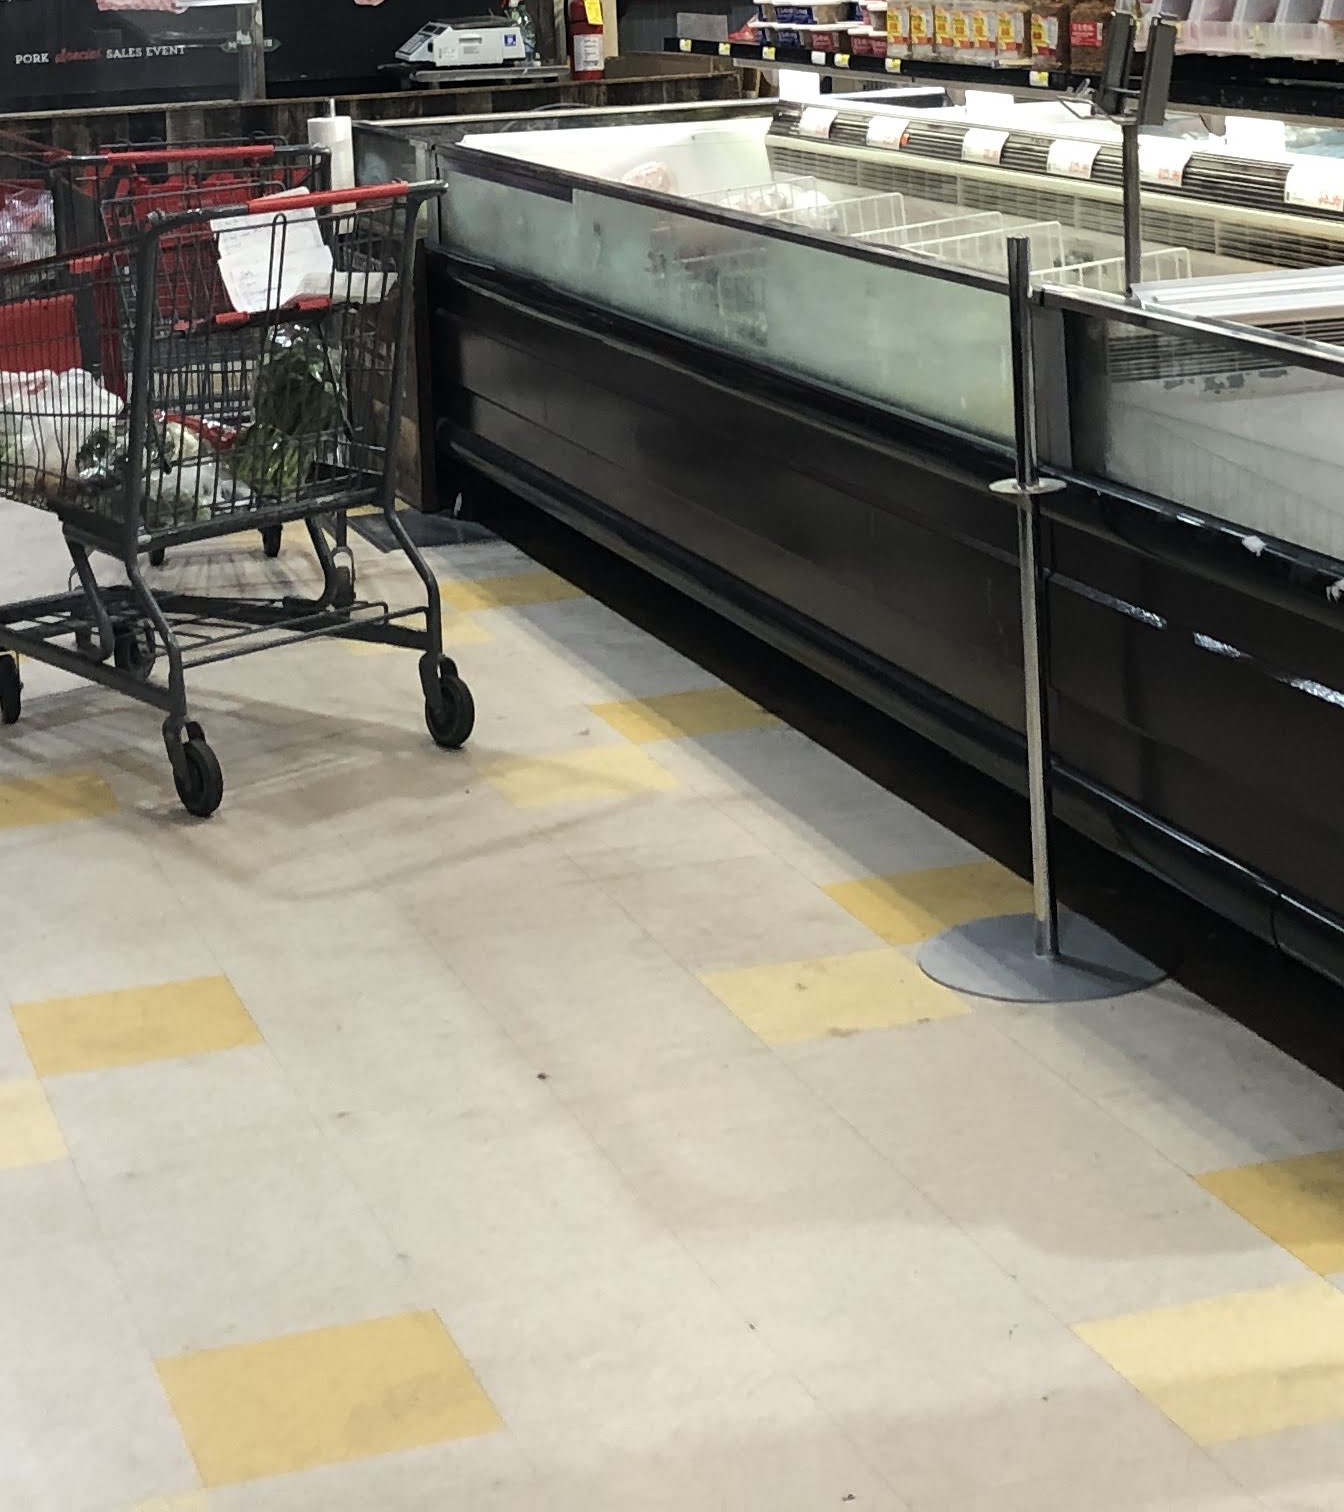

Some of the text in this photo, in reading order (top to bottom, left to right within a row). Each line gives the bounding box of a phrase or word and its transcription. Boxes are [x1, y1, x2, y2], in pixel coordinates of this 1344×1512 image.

[15, 45, 185, 65] PORK SALES EVENT
